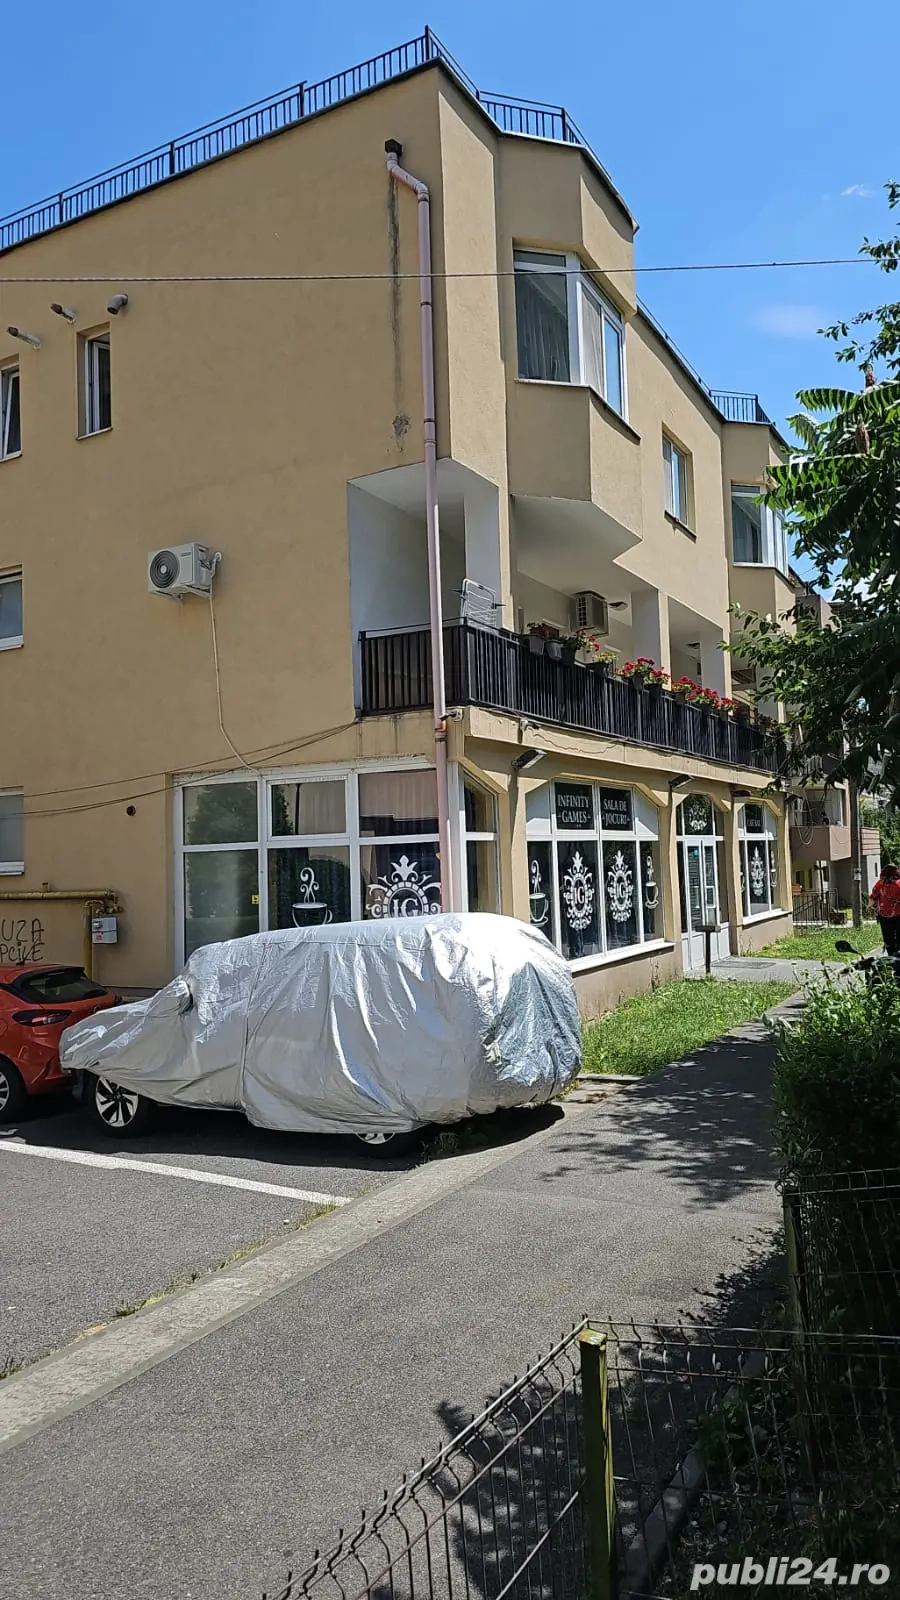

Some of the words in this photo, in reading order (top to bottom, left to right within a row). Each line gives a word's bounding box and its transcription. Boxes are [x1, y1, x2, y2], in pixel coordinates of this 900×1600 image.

[557, 794, 589, 808] INFINITY
[603, 798, 619, 811] SALA
[561, 809, 588, 823] GAMES
[605, 812, 628, 827] JOCURI
[573, 886, 585, 904] IG
[392, 898, 419, 918] IG
